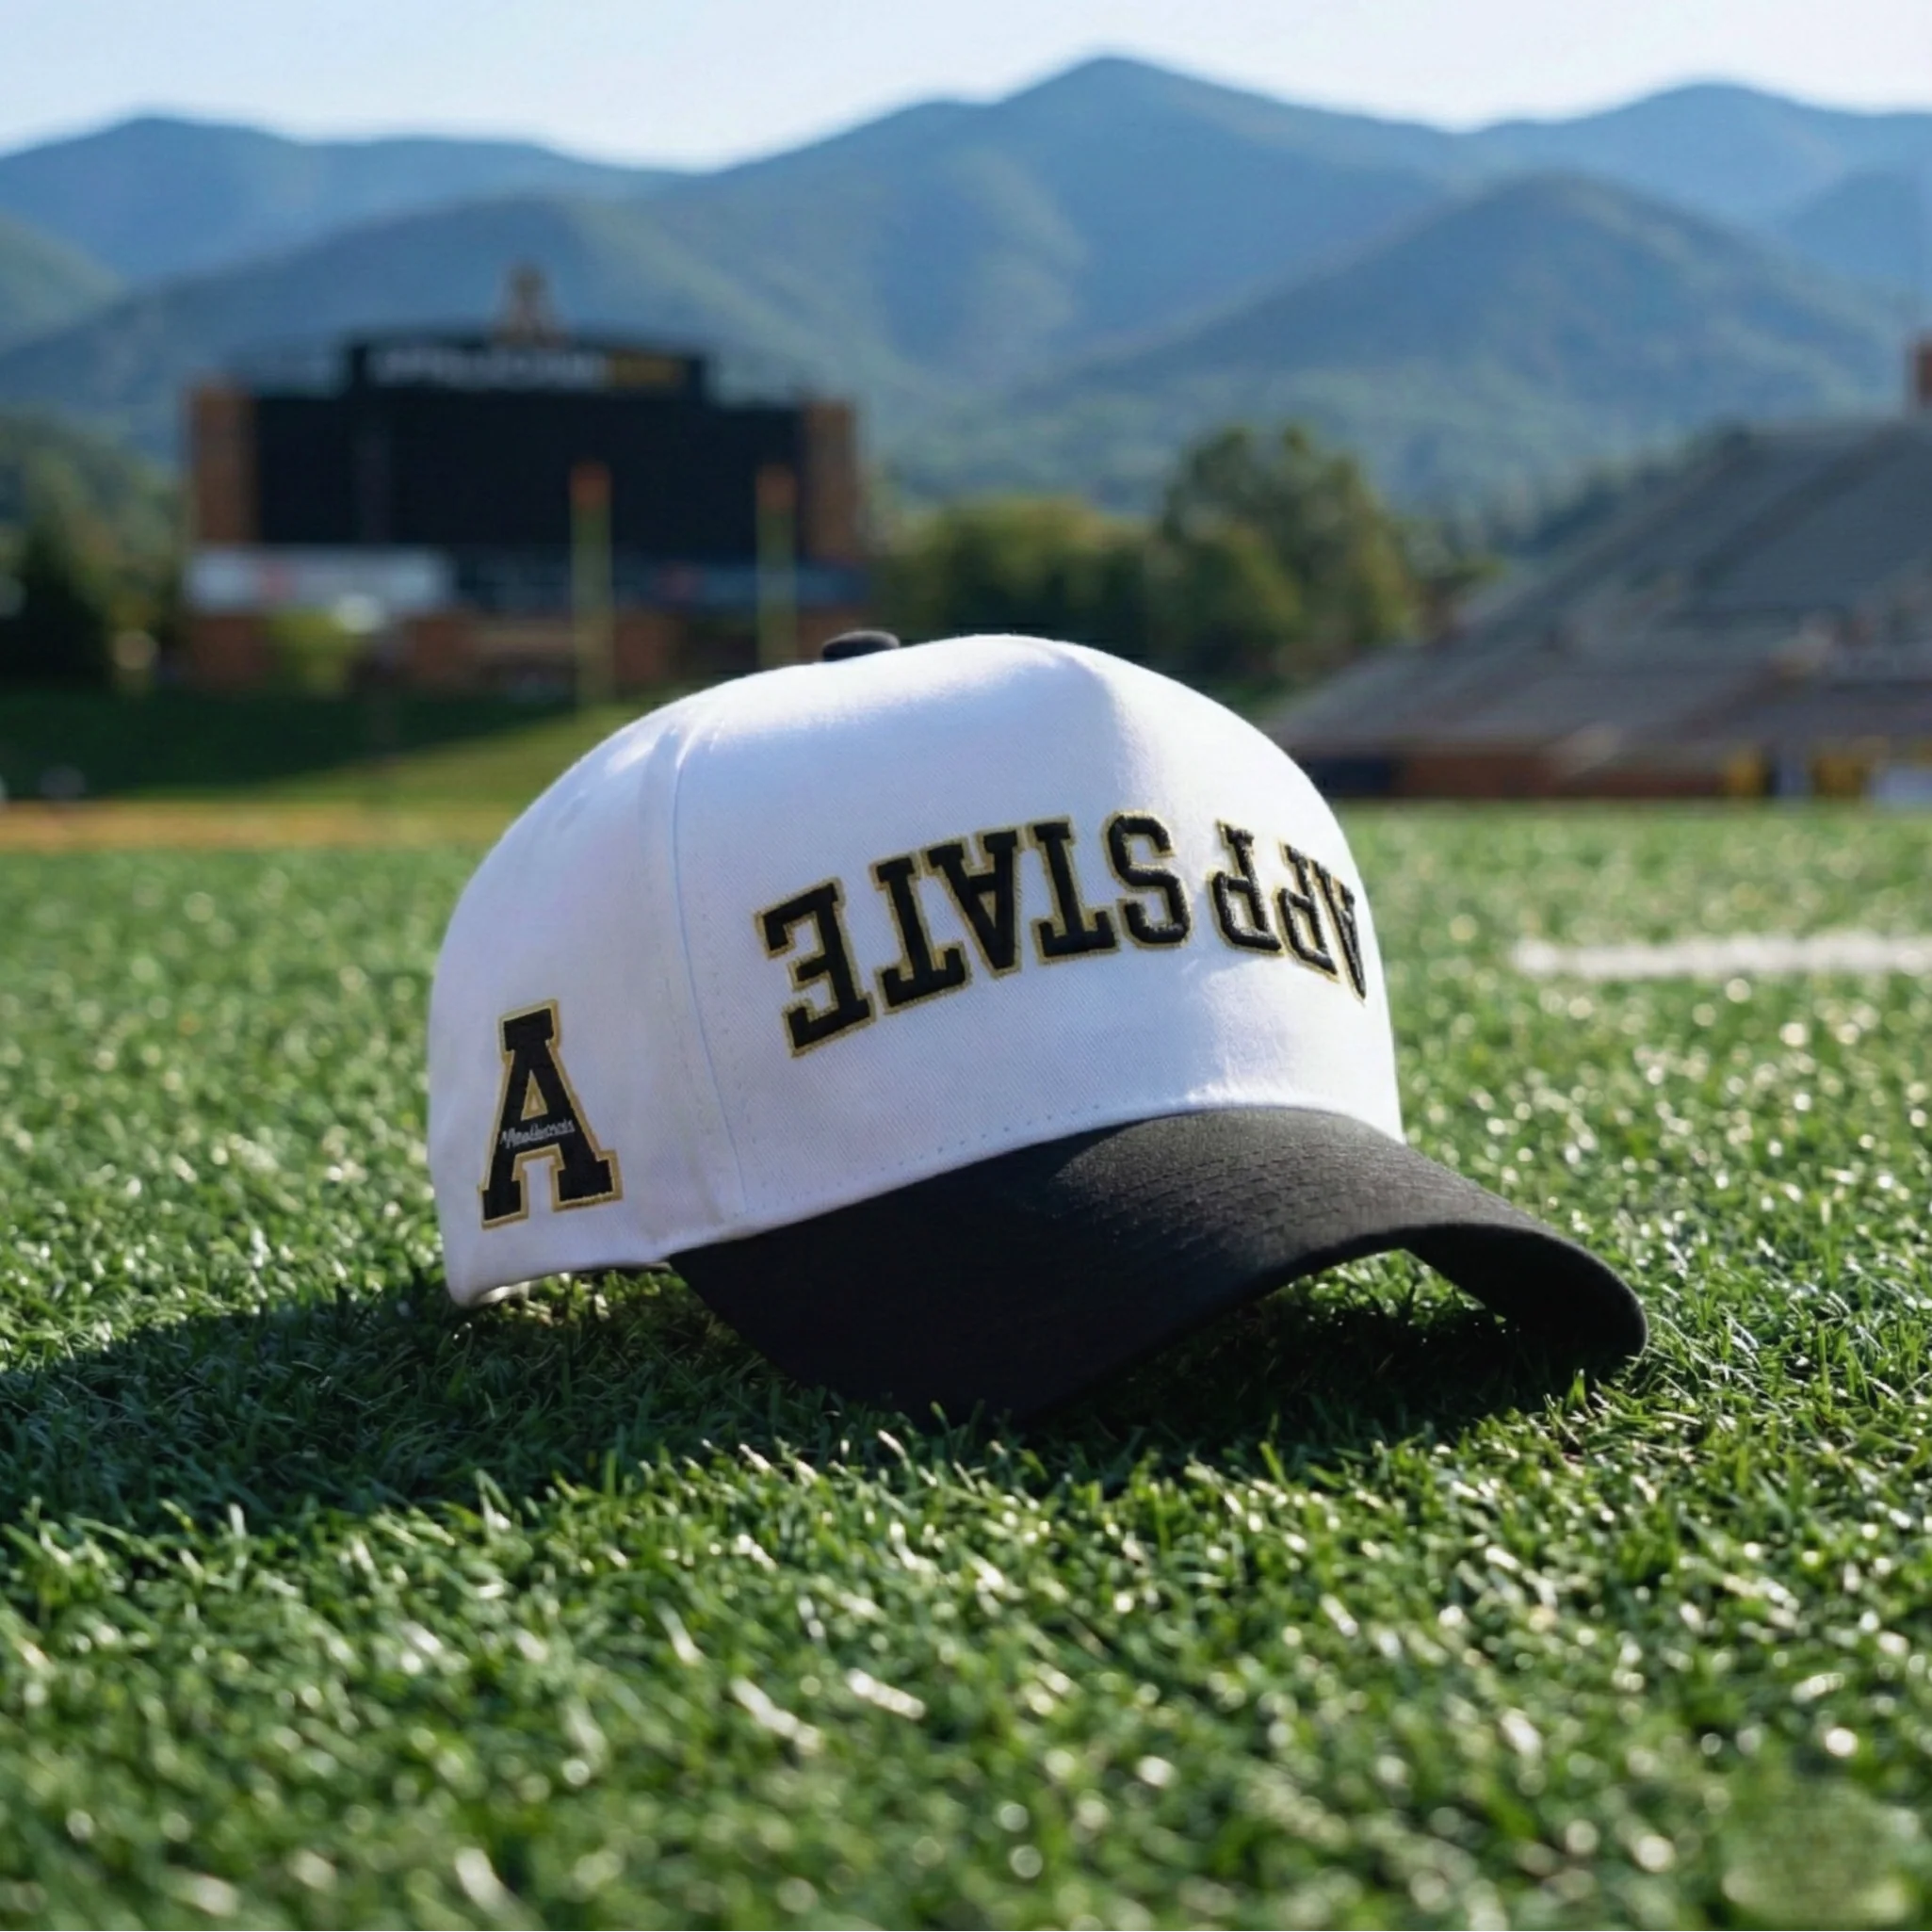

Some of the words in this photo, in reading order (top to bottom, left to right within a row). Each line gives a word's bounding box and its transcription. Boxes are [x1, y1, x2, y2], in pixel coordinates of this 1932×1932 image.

[755, 811, 1193, 1057] STATE
[1207, 818, 1367, 1002] APP
[479, 1000, 622, 1229] A
